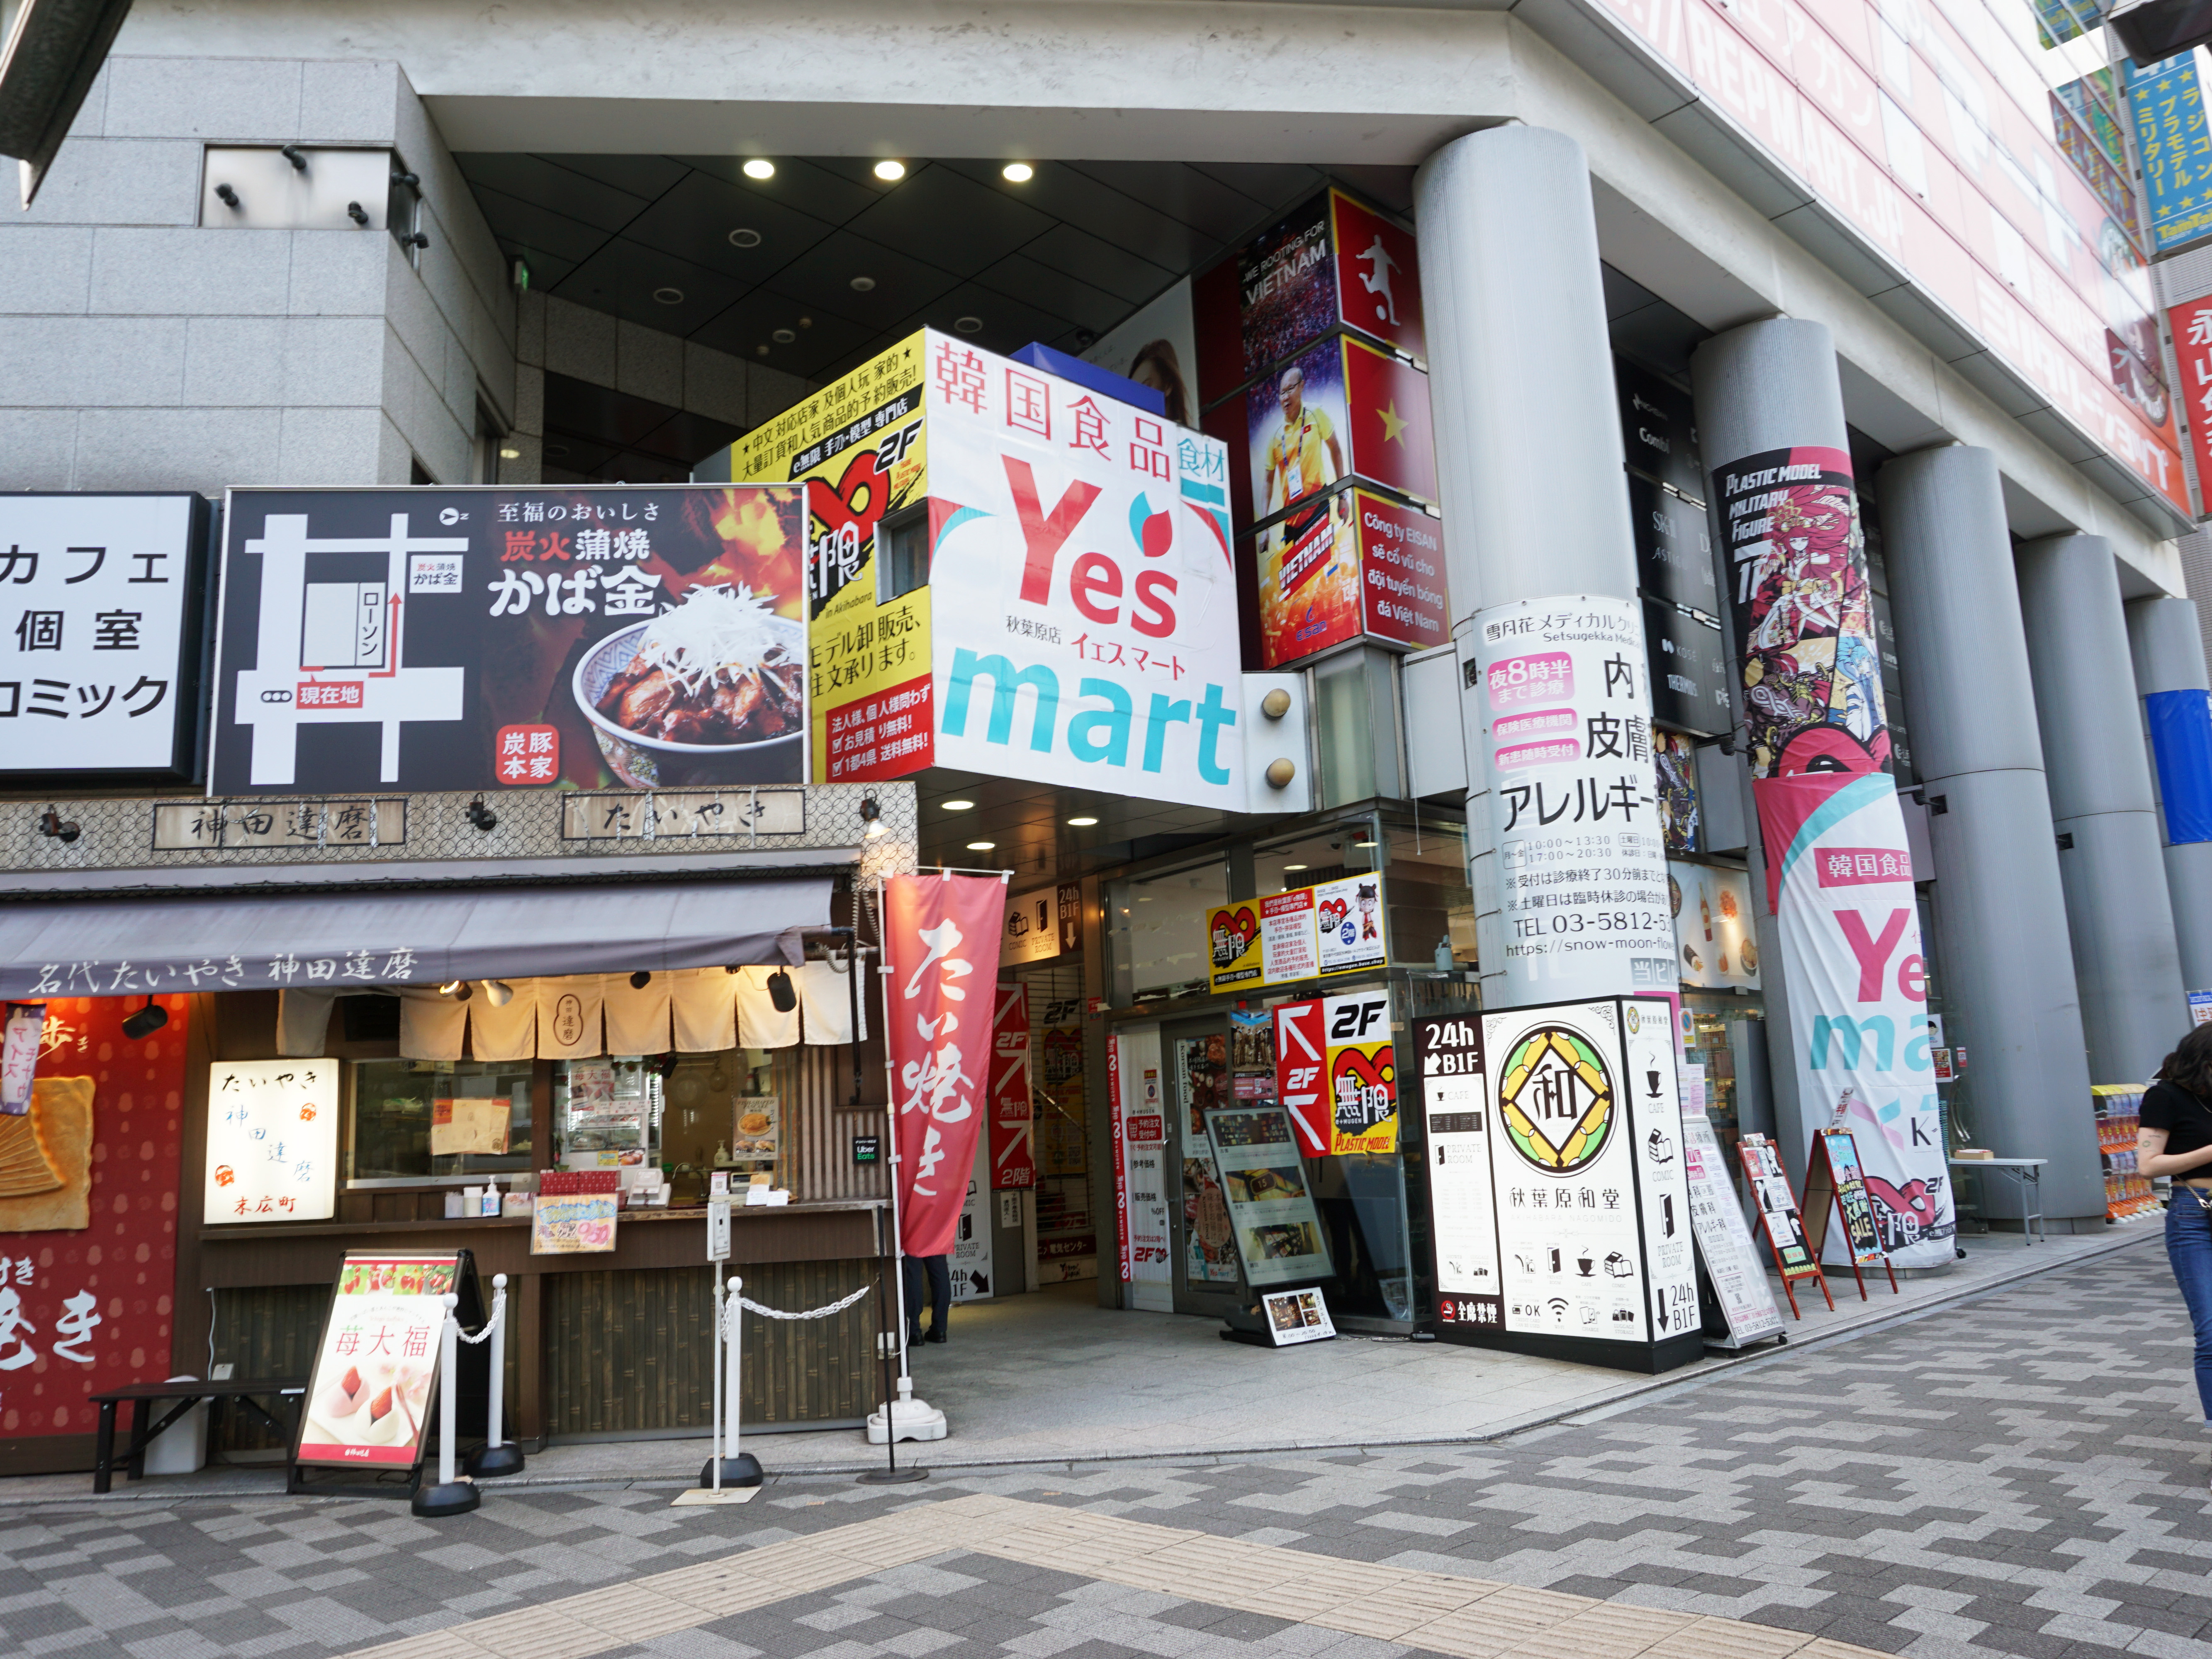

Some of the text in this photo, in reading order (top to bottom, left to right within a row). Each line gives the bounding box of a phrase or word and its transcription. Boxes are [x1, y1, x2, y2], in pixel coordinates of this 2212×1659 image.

[2159, 95, 2192, 189] プラモデル
[2182, 87, 2212, 180] ラジコン
[2138, 107, 2164, 196] ミリタリー
[1244, 220, 1325, 283] WE ROOTING FOR
[1246, 239, 1326, 305] VIETNAM
[1977, 277, 2168, 491] ミリタリーショップ
[935, 341, 1171, 483] 韓国食品
[874, 416, 925, 475] 2F
[1178, 438, 1225, 482] 食材
[1725, 464, 1822, 497] PLASTIC MODEL
[497, 502, 660, 522] 至福のおいしさ
[1729, 489, 1789, 520] MILITARY
[1364, 512, 1438, 551] Công ty EISAN
[1732, 516, 1774, 542] FIGURE
[501, 528, 650, 561] 炭火蒲焼
[1001, 453, 1179, 638] Yes
[1279, 522, 1334, 590] VIETNAM
[0, 545, 169, 585] カフェ
[417, 563, 456, 572] 炭火蒲焼
[1372, 544, 1385, 558] sẽ
[1416, 558, 1435, 577] cho
[414, 572, 459, 586] かば金
[1368, 569, 1385, 590] đội
[1416, 584, 1443, 609] bóng
[487, 566, 662, 617] かば金
[825, 592, 871, 618] in Akihabara
[1377, 600, 1440, 632] đá Việt Nam
[15, 609, 142, 652] 個室
[361, 592, 379, 657] ローソン
[1005, 615, 1062, 645] 秋葉原店
[1543, 632, 1613, 642] Setsugekka
[1489, 659, 1571, 690] 夜8時半
[1667, 674, 1698, 697] THERMOS
[0, 675, 168, 719] コミック
[299, 685, 360, 705] 現在地
[1498, 680, 1565, 704] まで診療
[832, 683, 931, 734] 法人様、個人様問わず
[940, 647, 1236, 785] mart
[1496, 713, 1572, 736] 保険医療機関
[1498, 744, 1574, 766] 新患随時受付
[1499, 774, 1658, 832] アレルギー
[191, 805, 369, 844] 神田達磨
[603, 800, 766, 830] たいやき
[1620, 835, 1639, 844] 土曜日
[1504, 849, 1525, 860] 月～金
[1828, 854, 1913, 878] 韓国食品
[1059, 886, 1079, 903] 24h
[1060, 901, 1079, 919] B1F
[1032, 933, 1054, 945] PRIVATE
[1513, 918, 1547, 938] TEL
[1009, 939, 1027, 950] COMIC
[1035, 943, 1052, 953] ROOM
[29, 947, 417, 994] 名代たいやき 神田達磨
[562, 999, 574, 1040] 神田達磨
[1331, 1000, 1386, 1039] 2F
[996, 1032, 1027, 1048] 2F
[1426, 1021, 1475, 1050] 24h
[901, 918, 974, 1196] たい焼き
[1443, 1052, 1479, 1074] B1F
[222, 1070, 317, 1092] たいやき
[1287, 1067, 1319, 1090] 2F
[1000, 1097, 1028, 1117] 無限
[1336, 1074, 1392, 1124] 無限
[1448, 1091, 1469, 1100] CAFE
[1648, 1103, 1664, 1113] CAFE
[1138, 1119, 1160, 1128] 予約注文
[1139, 1130, 1157, 1139] 受付中!
[225, 1104, 314, 1182] 神田達磨
[1336, 1133, 1391, 1152] PLASTIC MODEL
[1447, 1144, 1481, 1153] PRIVATE
[1133, 1160, 1155, 1169] 参考価格
[1447, 1155, 1473, 1164] ROOM
[1001, 1168, 1029, 1185] 2階
[1258, 1178, 1267, 1188] 15
[1652, 1169, 1674, 1182] COMIC
[1924, 1176, 1943, 1195] 2F
[234, 1196, 297, 1216] 末広町
[1134, 1192, 1156, 1202] 販売価格
[1509, 1187, 1621, 1209] 秋葉原和堂
[1151, 1207, 1164, 1216] %OFF
[578, 1221, 611, 1245] 950
[1696, 1218, 1727, 1235] アレルギー科
[1850, 1217, 1874, 1244] SALE
[956, 1250, 976, 1258] ROOM
[1134, 1247, 1155, 1262] 2F
[1657, 1242, 1684, 1258] PRIVATE
[1662, 1254, 1681, 1269] ROOM
[1670, 1283, 1695, 1306] 24h
[1458, 1301, 1497, 1323] 全席禁煙
[1525, 1305, 1541, 1317] OK
[1674, 1308, 1696, 1331] B1F
[1734, 1316, 1779, 1335] TEL 03-5812-5301
[336, 1325, 430, 1357] 苺大福
